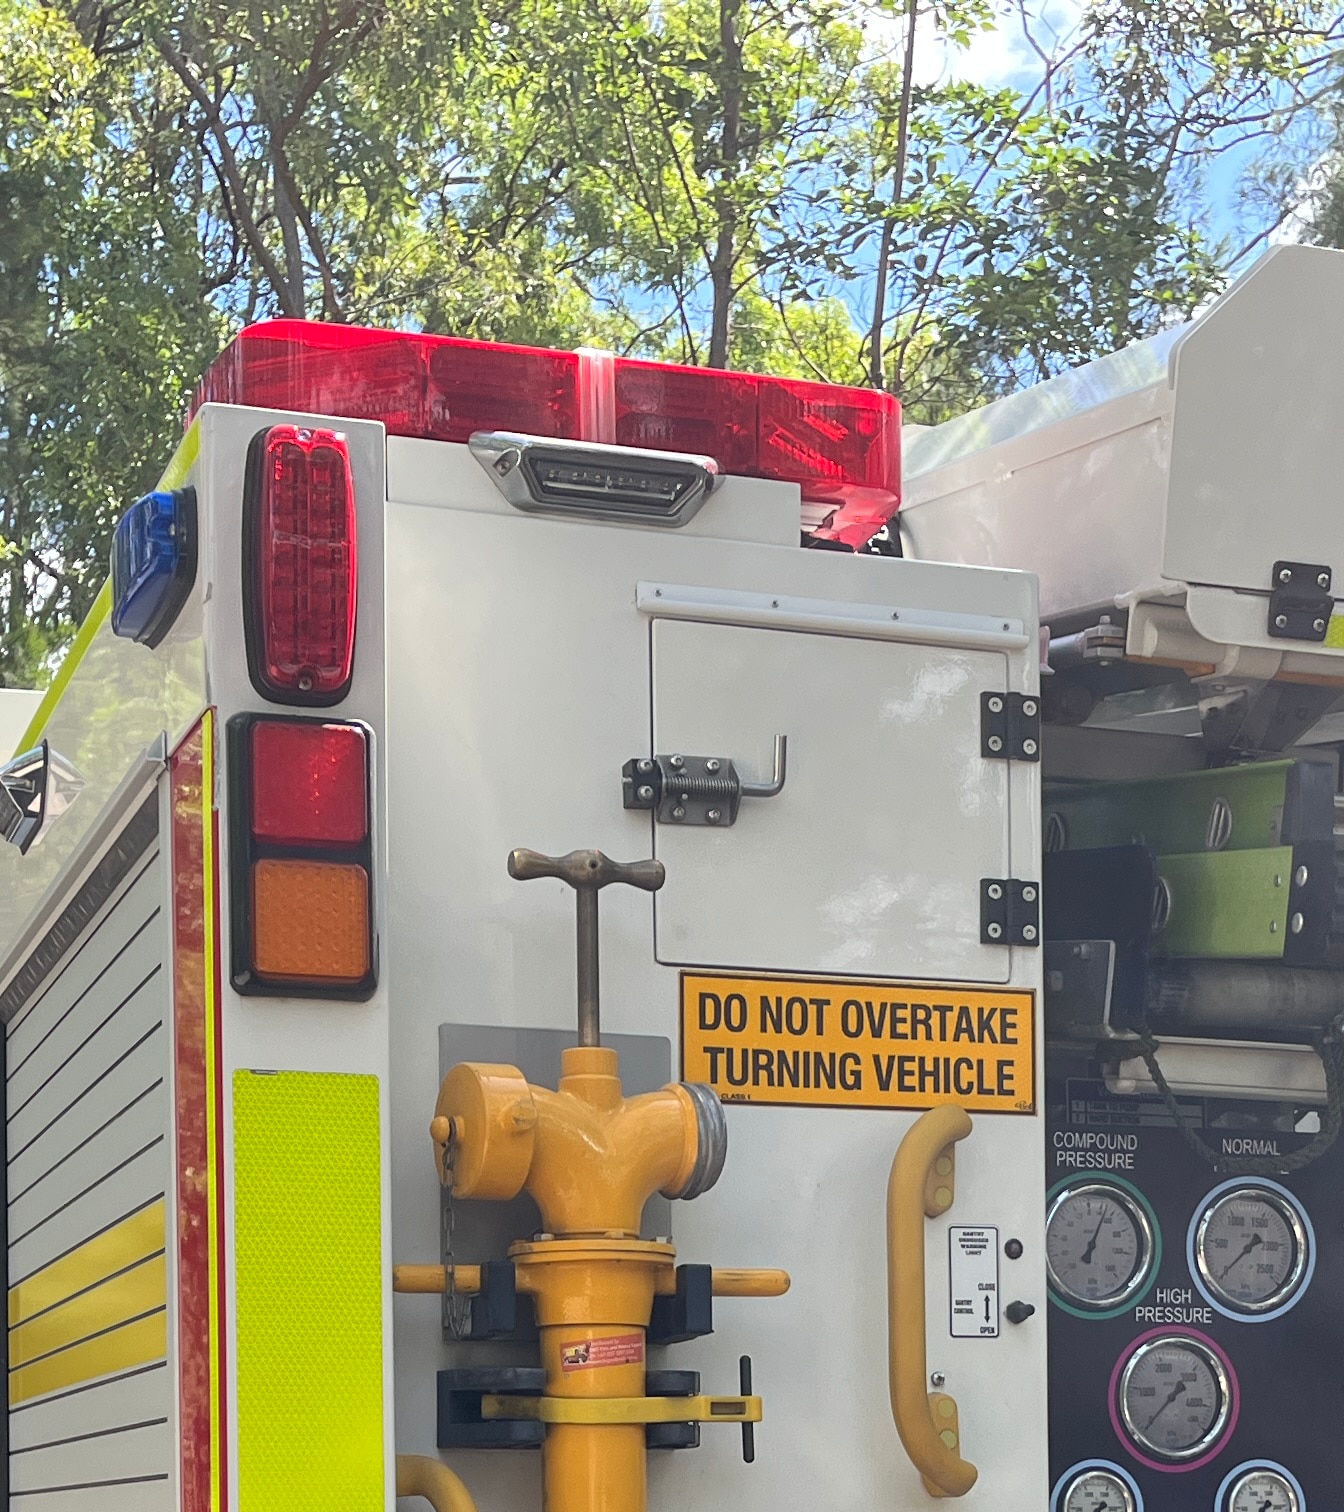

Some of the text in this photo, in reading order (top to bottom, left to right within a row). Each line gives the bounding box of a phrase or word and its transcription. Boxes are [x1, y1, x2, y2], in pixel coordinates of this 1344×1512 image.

[698, 992, 1018, 1045] DO NOT OVERTAKE
[703, 1046, 1015, 1096] TURNING VEHICLE
[1053, 1132, 1138, 1150] COMPOUND
[1222, 1138, 1281, 1157] NORMAL
[1056, 1151, 1135, 1170] PRESSURE
[1214, 1238, 1228, 1249] 500
[1156, 1288, 1192, 1305] HIGH
[1135, 1306, 1213, 1324] PRESSURE
